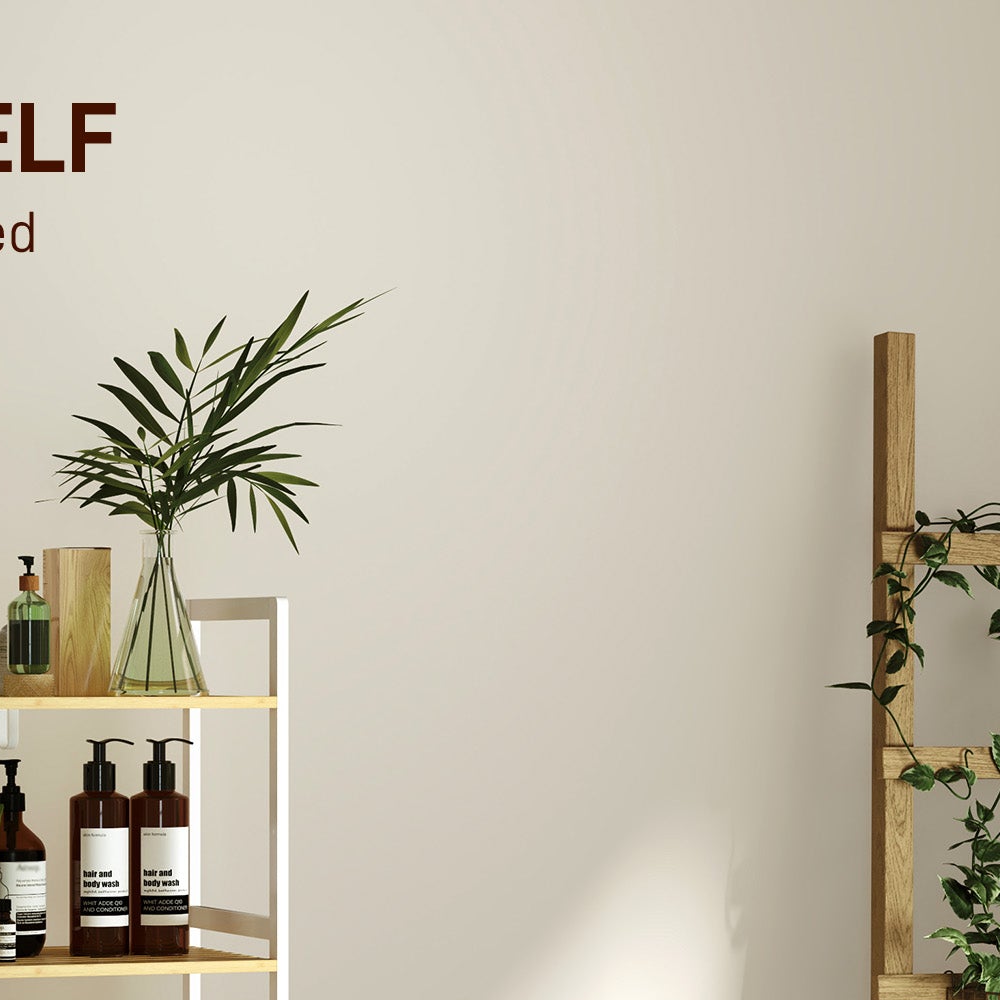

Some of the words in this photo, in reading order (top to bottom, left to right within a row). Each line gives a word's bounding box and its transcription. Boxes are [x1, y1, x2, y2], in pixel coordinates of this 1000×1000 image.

[83, 870, 97, 878] hair
[99, 870, 113, 878] and
[143, 869, 158, 877] hair
[158, 869, 173, 877] and
[83, 880, 101, 889] body
[101, 880, 120, 888] wash
[143, 879, 161, 888] body
[161, 879, 180, 887] wash
